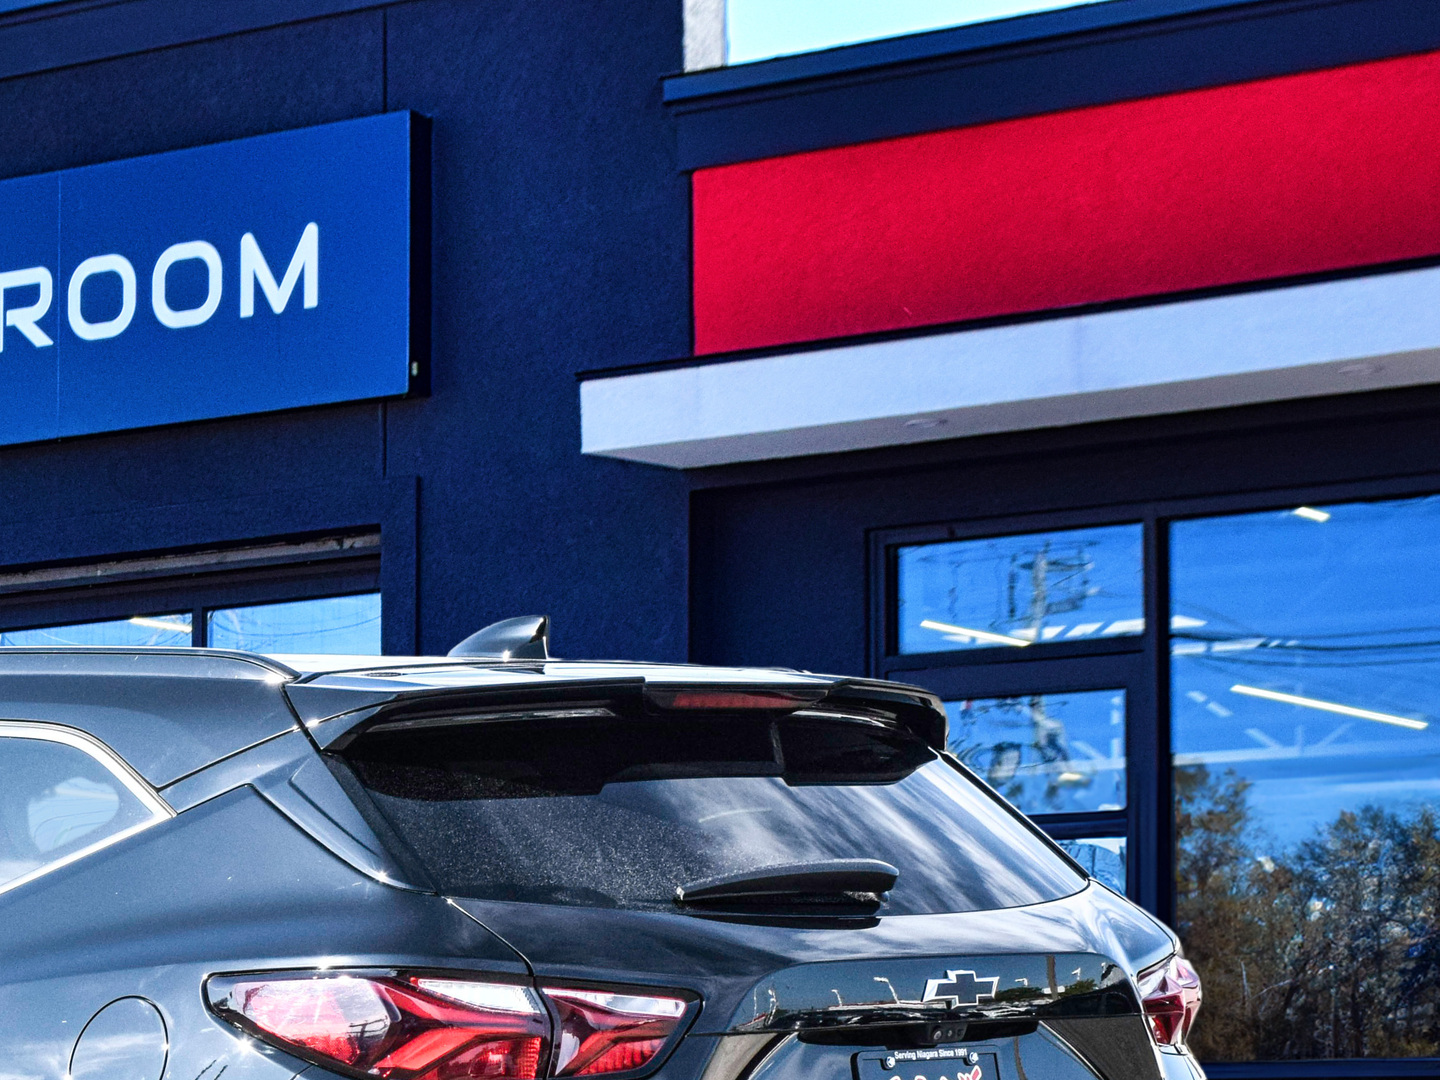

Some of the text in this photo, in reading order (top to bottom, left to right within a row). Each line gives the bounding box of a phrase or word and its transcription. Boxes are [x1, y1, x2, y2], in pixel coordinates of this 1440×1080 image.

[894, 1048, 968, 1060] Serving Niagara Since 1991
